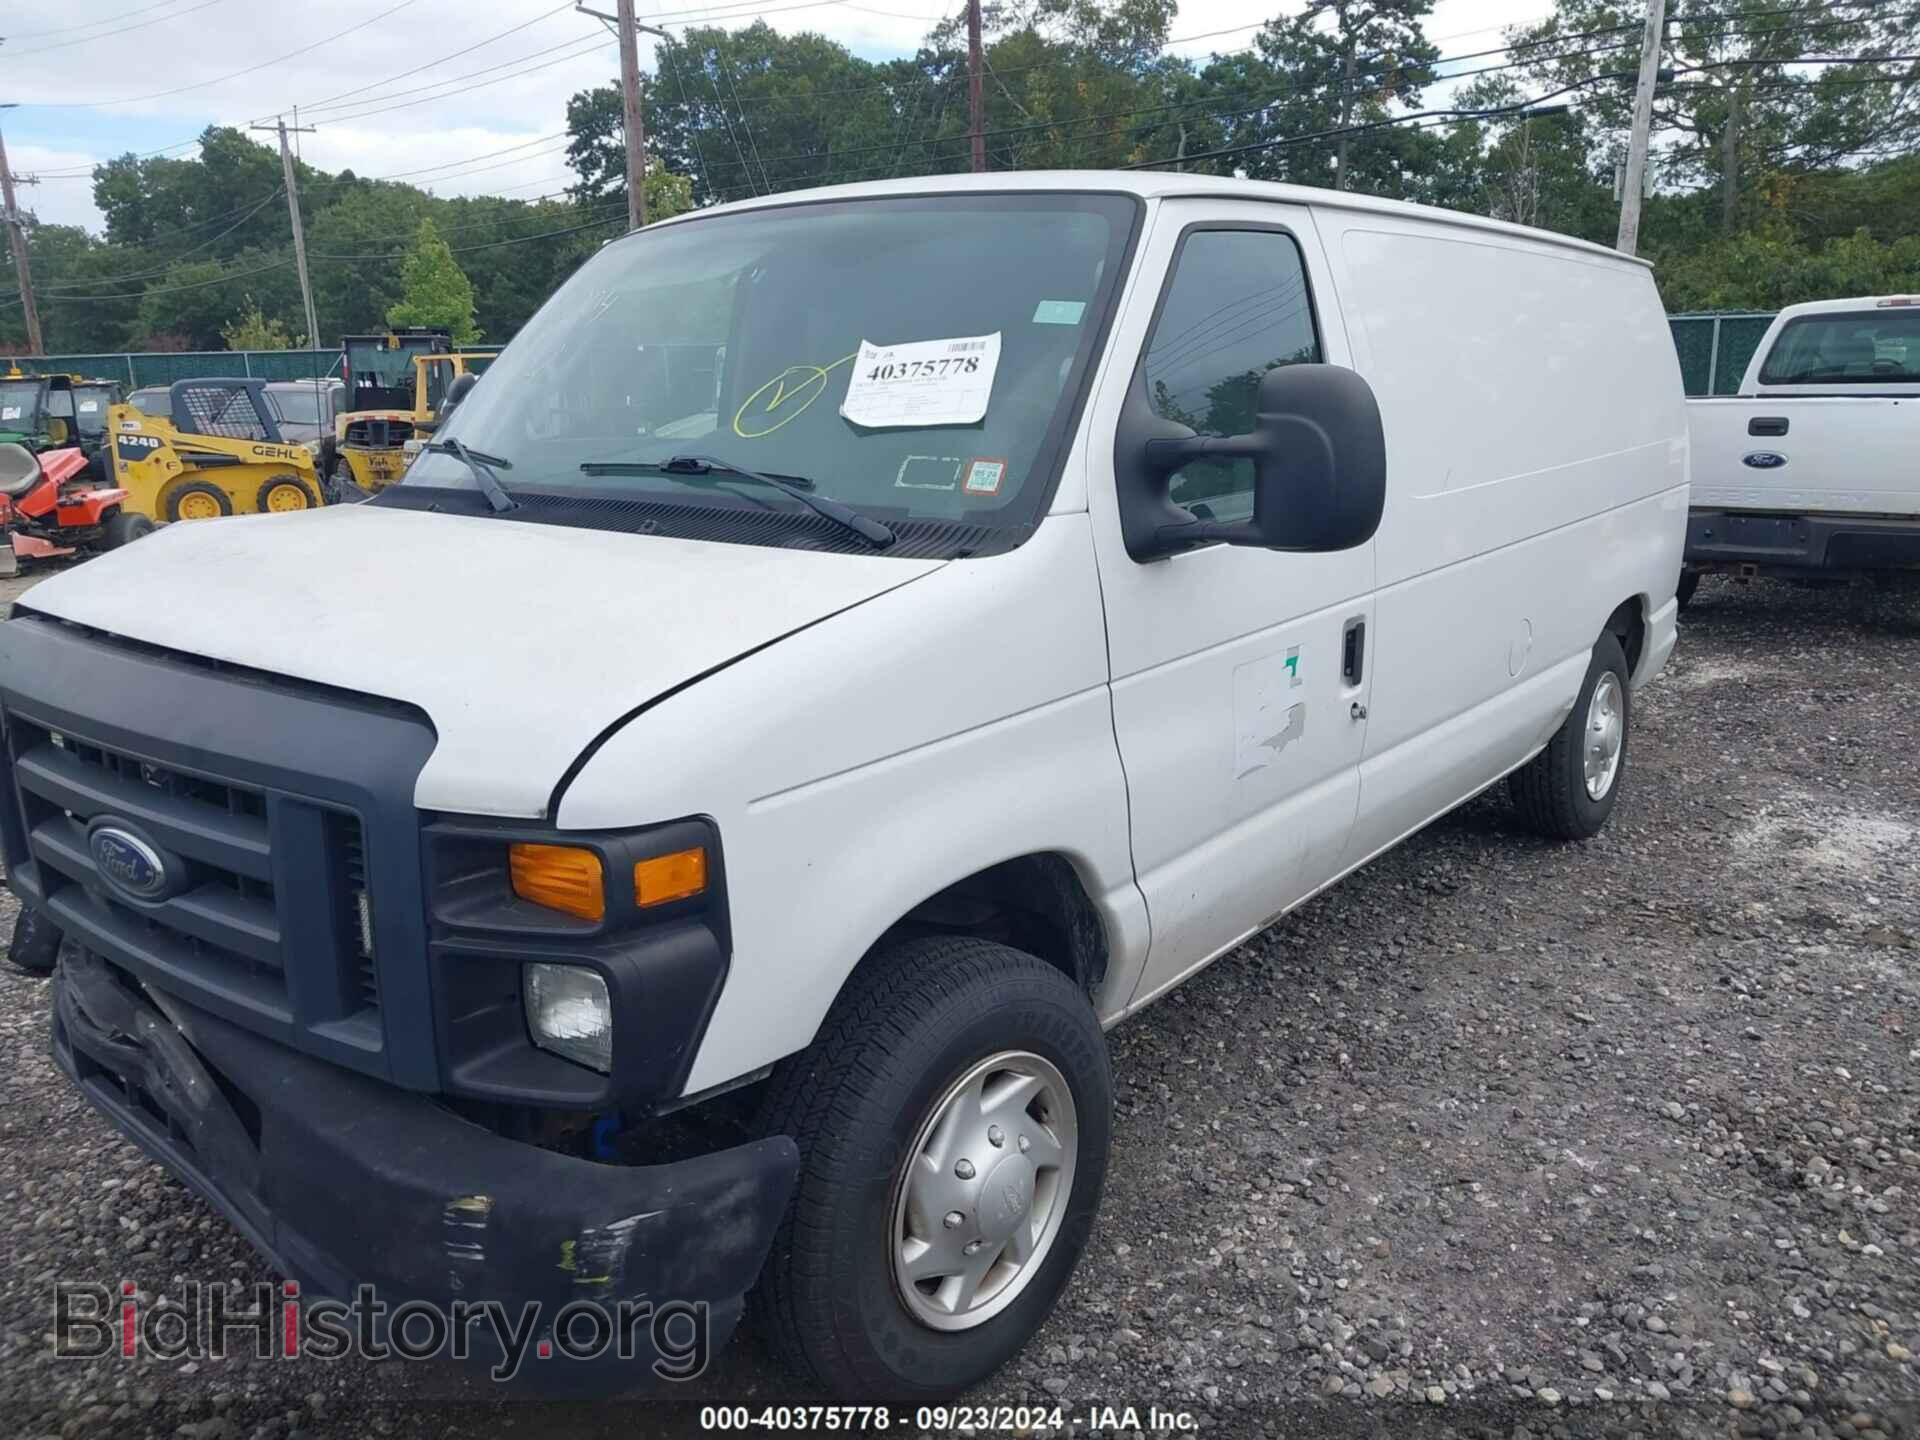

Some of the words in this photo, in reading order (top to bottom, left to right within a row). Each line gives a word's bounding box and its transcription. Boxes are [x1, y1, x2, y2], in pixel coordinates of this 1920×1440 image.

[866, 355, 980, 381] 40375778
[118, 435, 159, 448] 4240
[252, 444, 299, 460] GEHL
